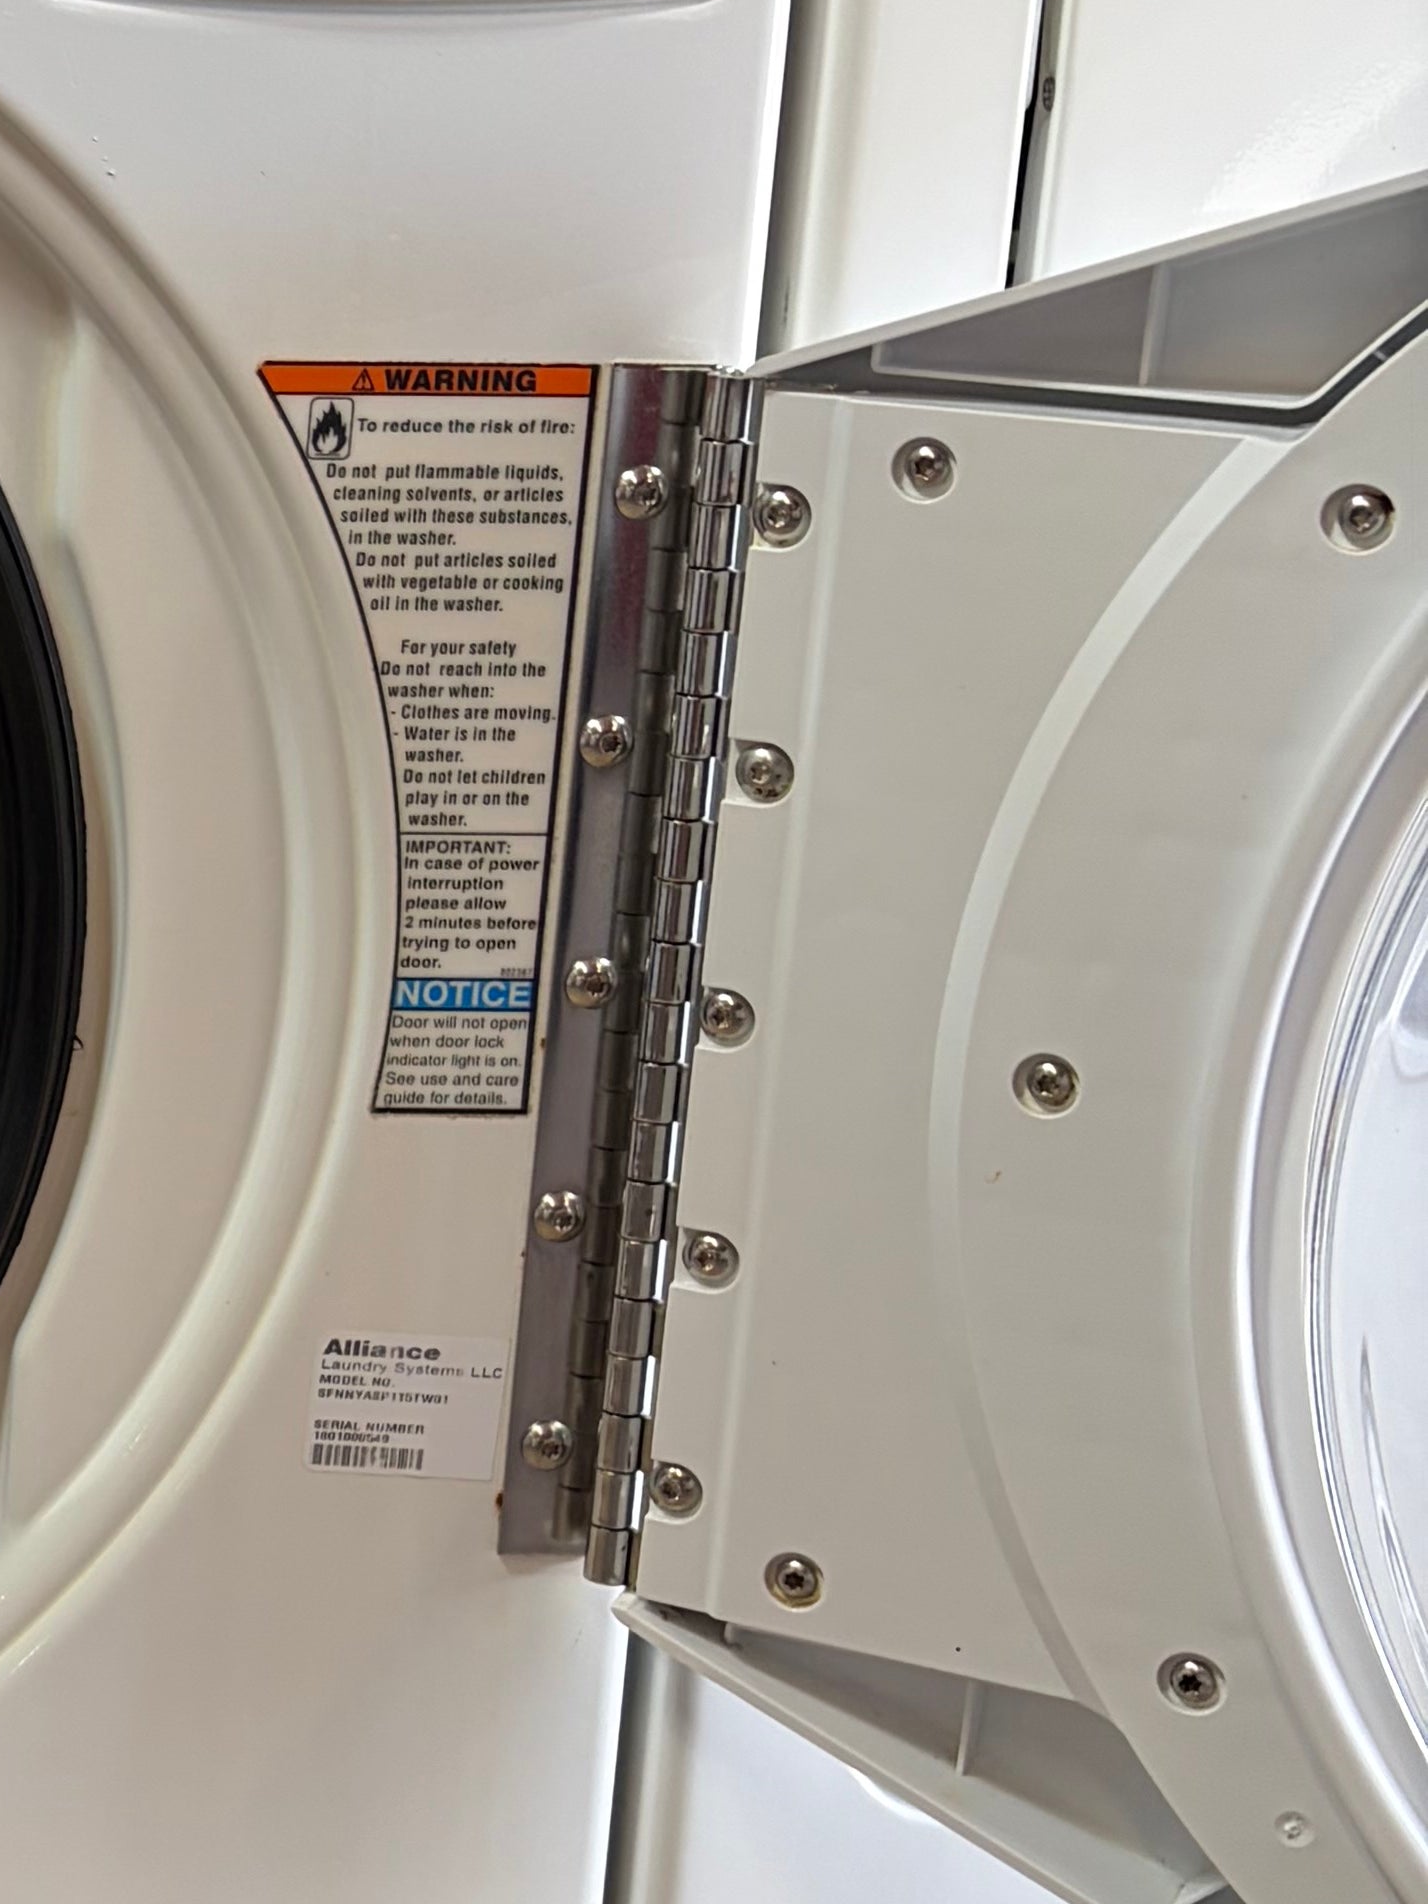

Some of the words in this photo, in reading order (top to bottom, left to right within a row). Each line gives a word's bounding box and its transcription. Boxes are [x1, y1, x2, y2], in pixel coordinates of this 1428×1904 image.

[382, 368, 536, 392] WARNING
[358, 418, 377, 432] To
[383, 419, 442, 432] reduce
[449, 419, 475, 433] the
[481, 420, 513, 433] risk
[519, 420, 536, 433] of
[541, 420, 575, 434] fire:
[406, 840, 510, 853] IMPORTANT:
[397, 980, 531, 1007] NOTICE
[324, 1339, 440, 1360] Alliance
[322, 1359, 387, 1374] Laundry
[395, 1362, 464, 1376] Systems
[471, 1367, 503, 1379] LLC
